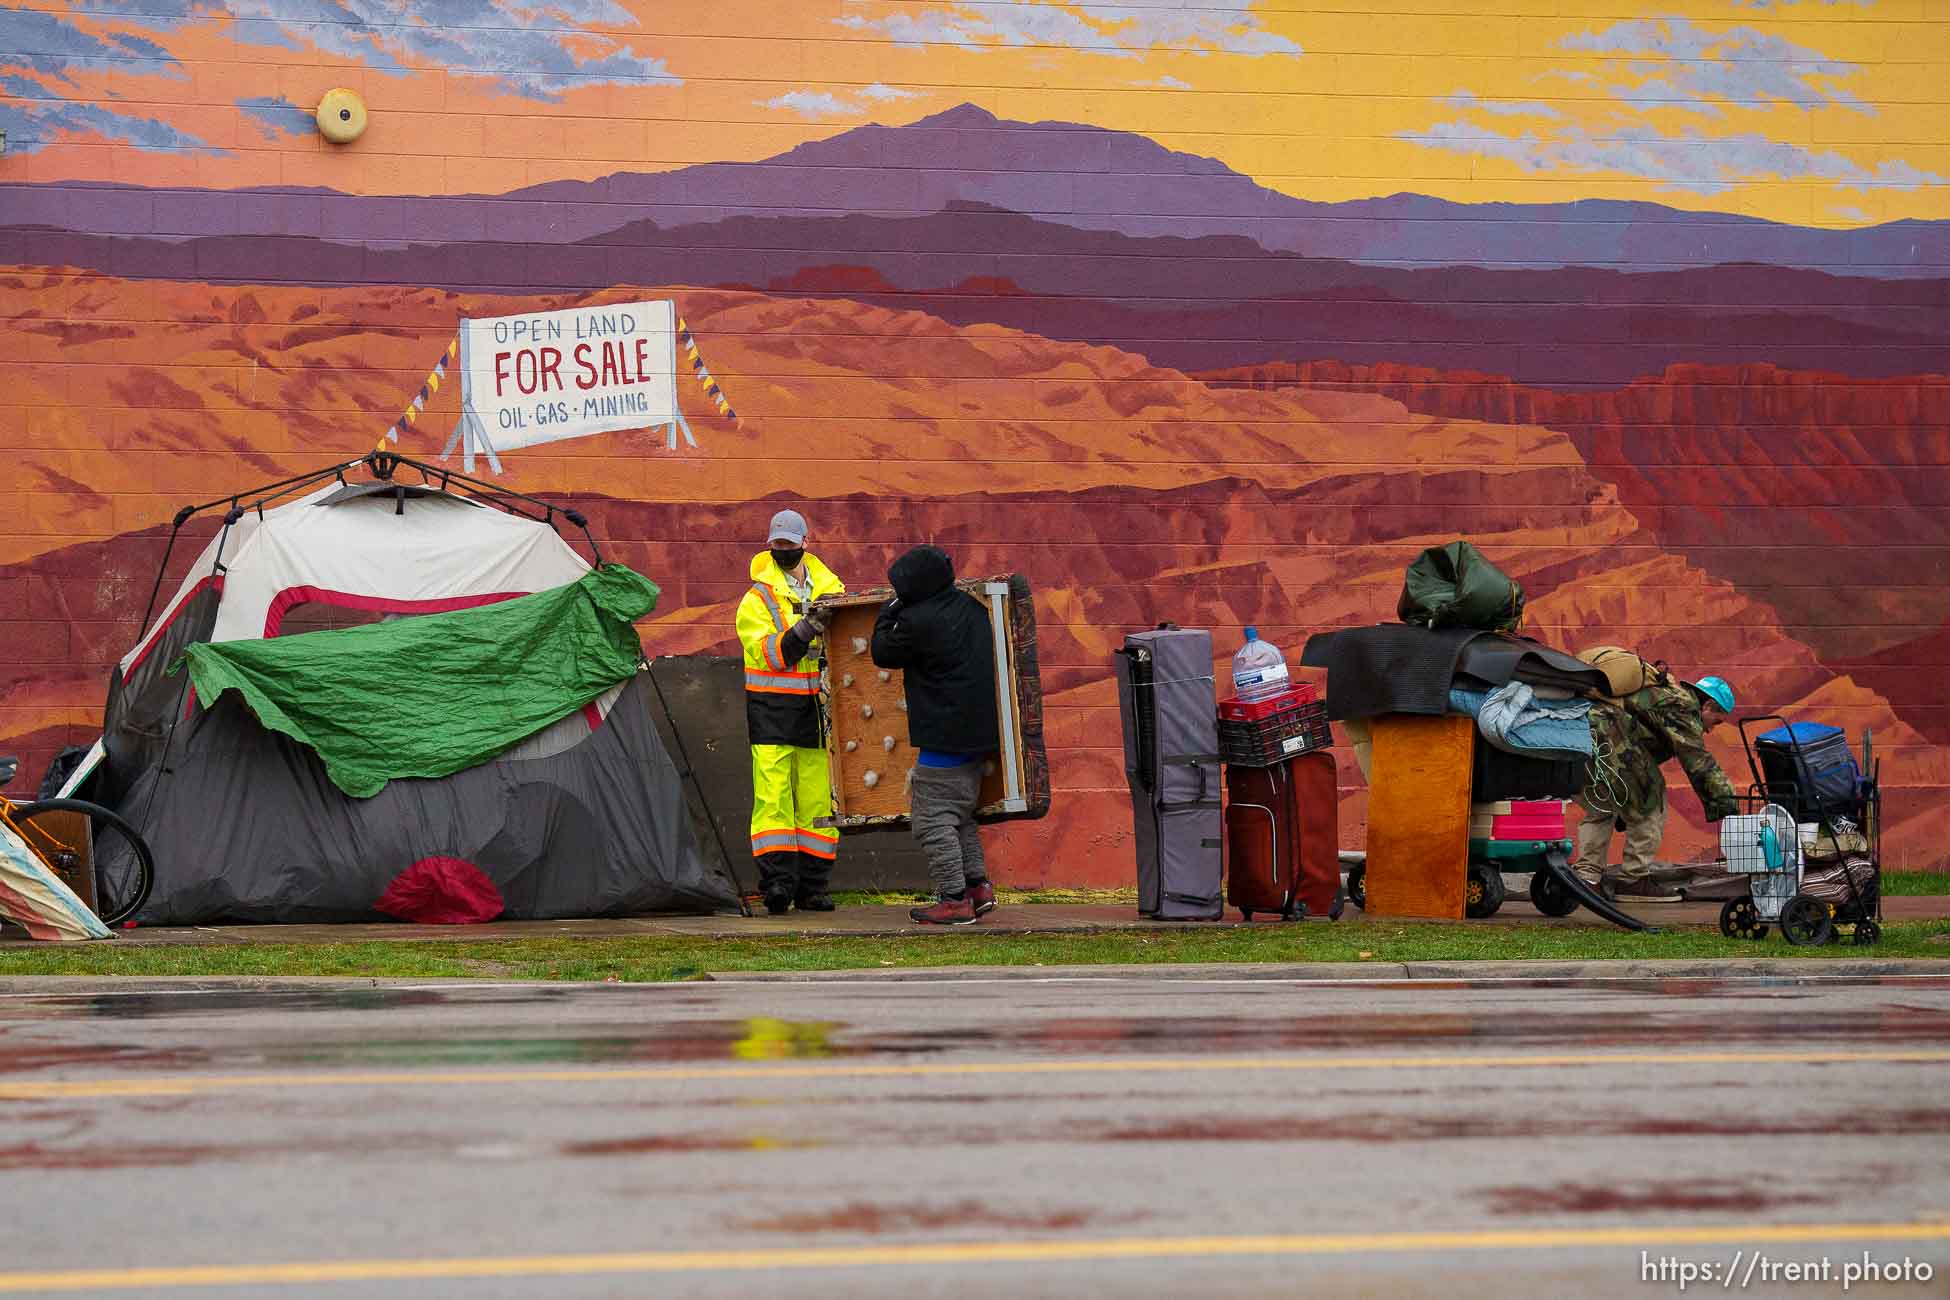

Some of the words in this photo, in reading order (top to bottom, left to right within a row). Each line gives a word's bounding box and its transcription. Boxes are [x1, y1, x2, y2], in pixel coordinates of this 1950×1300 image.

[494, 319, 561, 343] OPEN
[576, 313, 635, 339] LAND
[495, 347, 564, 396] FOR
[574, 339, 651, 390] SALE
[499, 407, 527, 429] OIL
[536, 401, 569, 425] GAS
[583, 392, 648, 420] MINING
